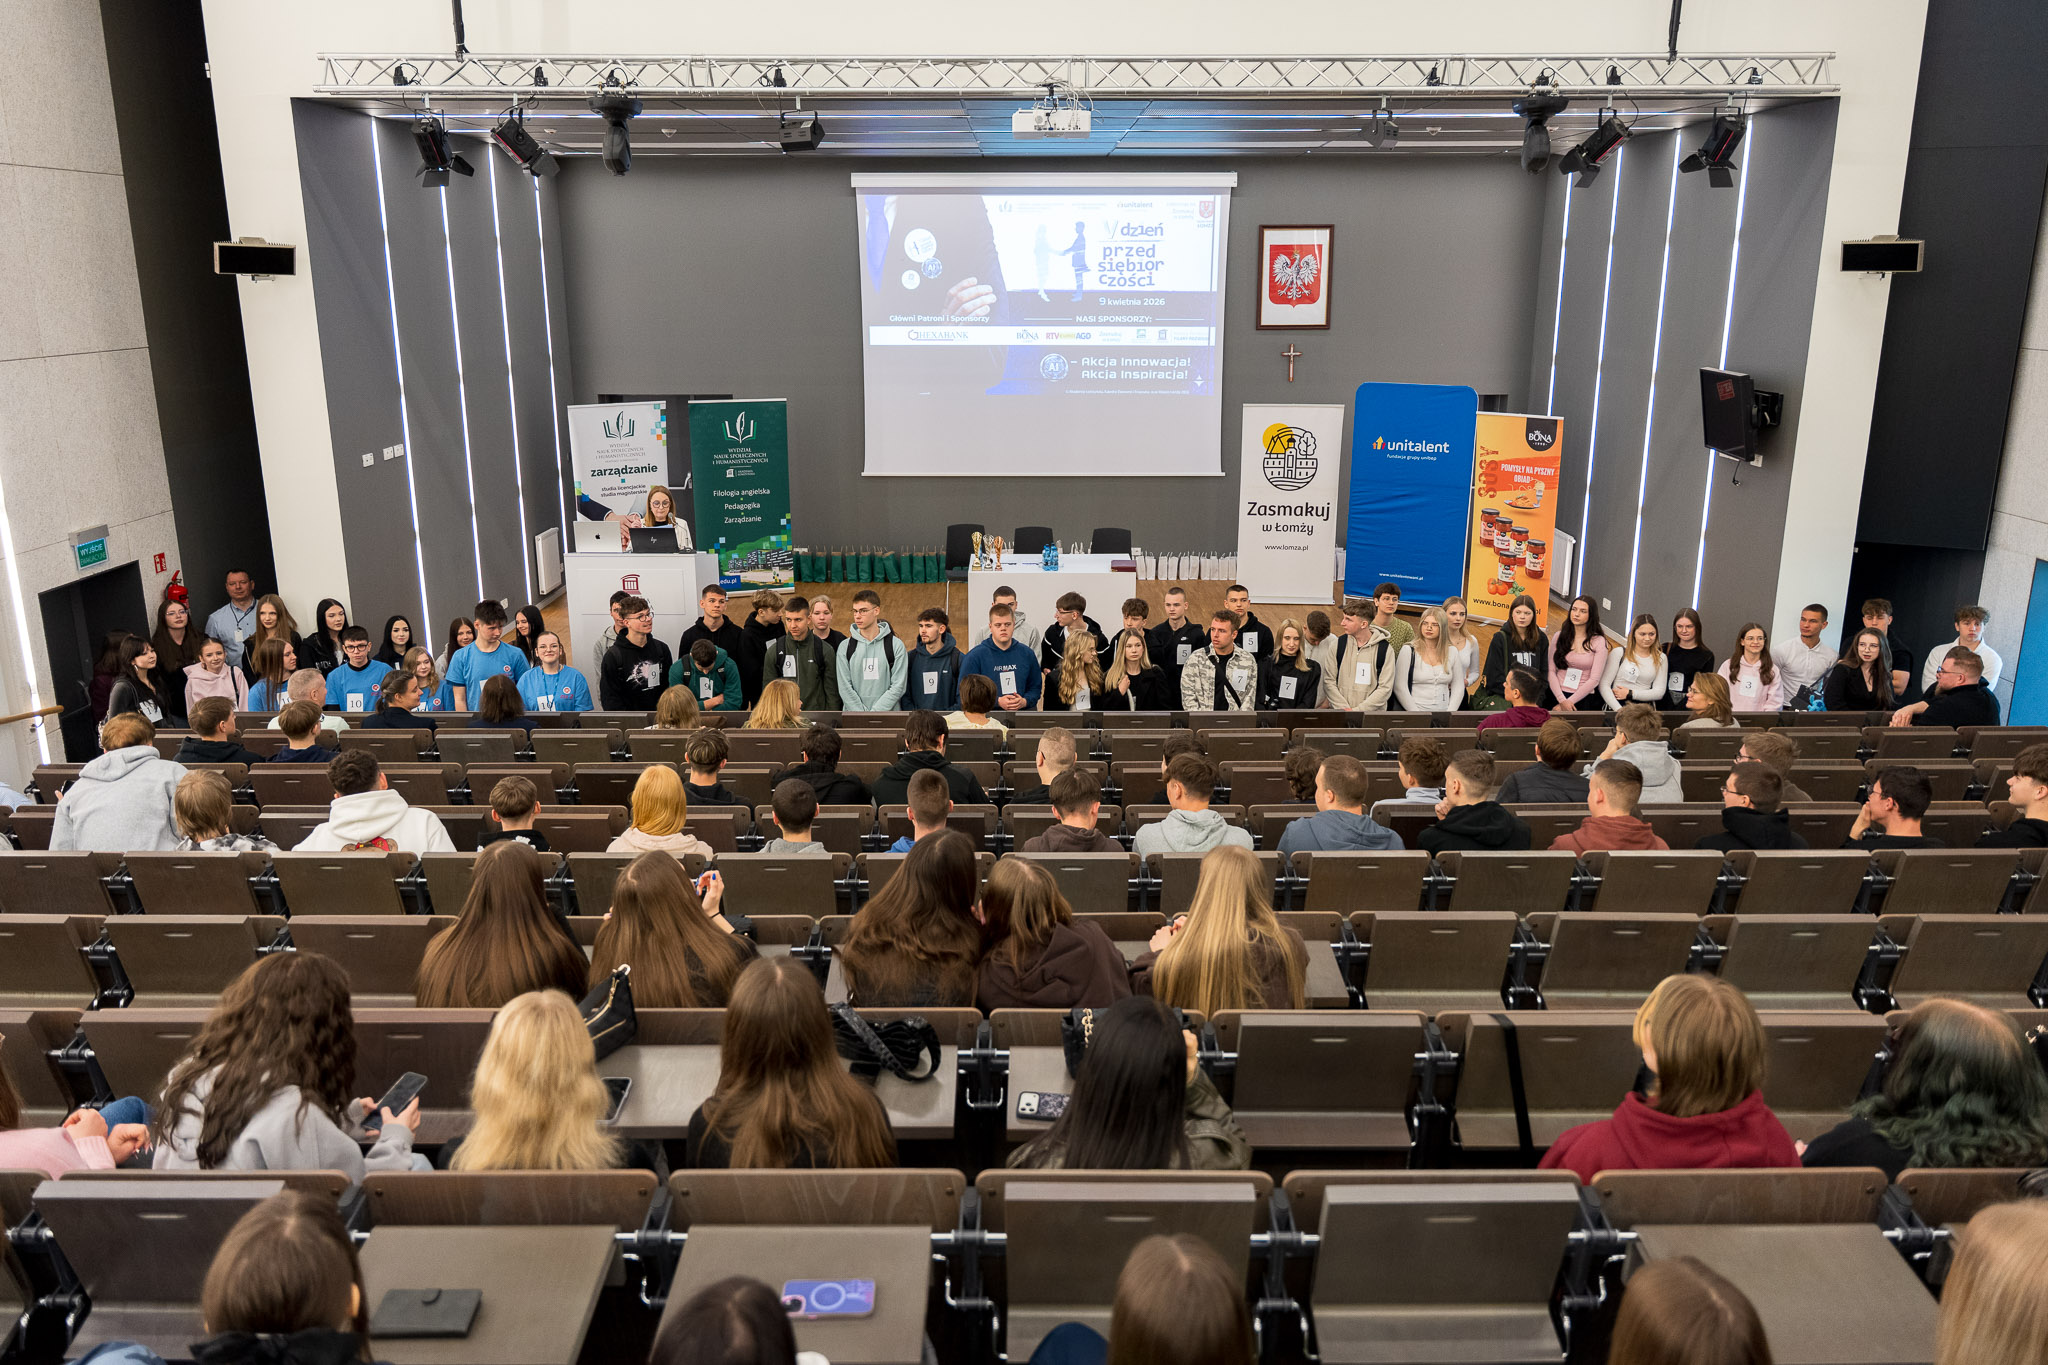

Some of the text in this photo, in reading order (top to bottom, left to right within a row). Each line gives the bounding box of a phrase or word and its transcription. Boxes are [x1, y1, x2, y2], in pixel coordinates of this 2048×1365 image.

[1120, 222, 1164, 237] dzień
[1102, 244, 1156, 261] przed
[1097, 257, 1165, 276] siębior
[1098, 271, 1156, 288] czości
[1098, 297, 1166, 306] 9 kwietnia 2026
[889, 314, 916, 322] Główni
[917, 314, 945, 322] Patroni
[950, 315, 990, 324] Sponsorzy
[1075, 315, 1153, 323] NASI SPONSORZY:
[1081, 357, 1117, 368] Akcja
[1121, 356, 1192, 368] Innowacja!
[1081, 370, 1189, 380] Akcja Inspiracja!
[1528, 432, 1552, 443] BONA
[1387, 439, 1450, 454] unitalent
[590, 463, 659, 478] zarządzanie
[1478, 445, 1499, 499] SOSY
[1500, 463, 1555, 476] POMYSŁY NA PYSZNY
[1513, 474, 1531, 484] OBIAD
[713, 487, 771, 497] Filologia angielska
[724, 502, 761, 510] Pedagogika
[1247, 501, 1331, 521] Zasmakuj
[724, 515, 762, 524] Zarządzanie
[1262, 522, 1314, 536] w Łomży
[1248, 638, 1254, 646] 5
[1182, 649, 1187, 657] 5
[785, 661, 791, 669] 9
[651, 671, 656, 679] 9
[1237, 675, 1243, 683] 7
[928, 678, 935, 686] 9
[1005, 677, 1011, 686] 7
[1745, 681, 1752, 689] 3
[1080, 694, 1086, 702] 7
[350, 700, 362, 708] 10
